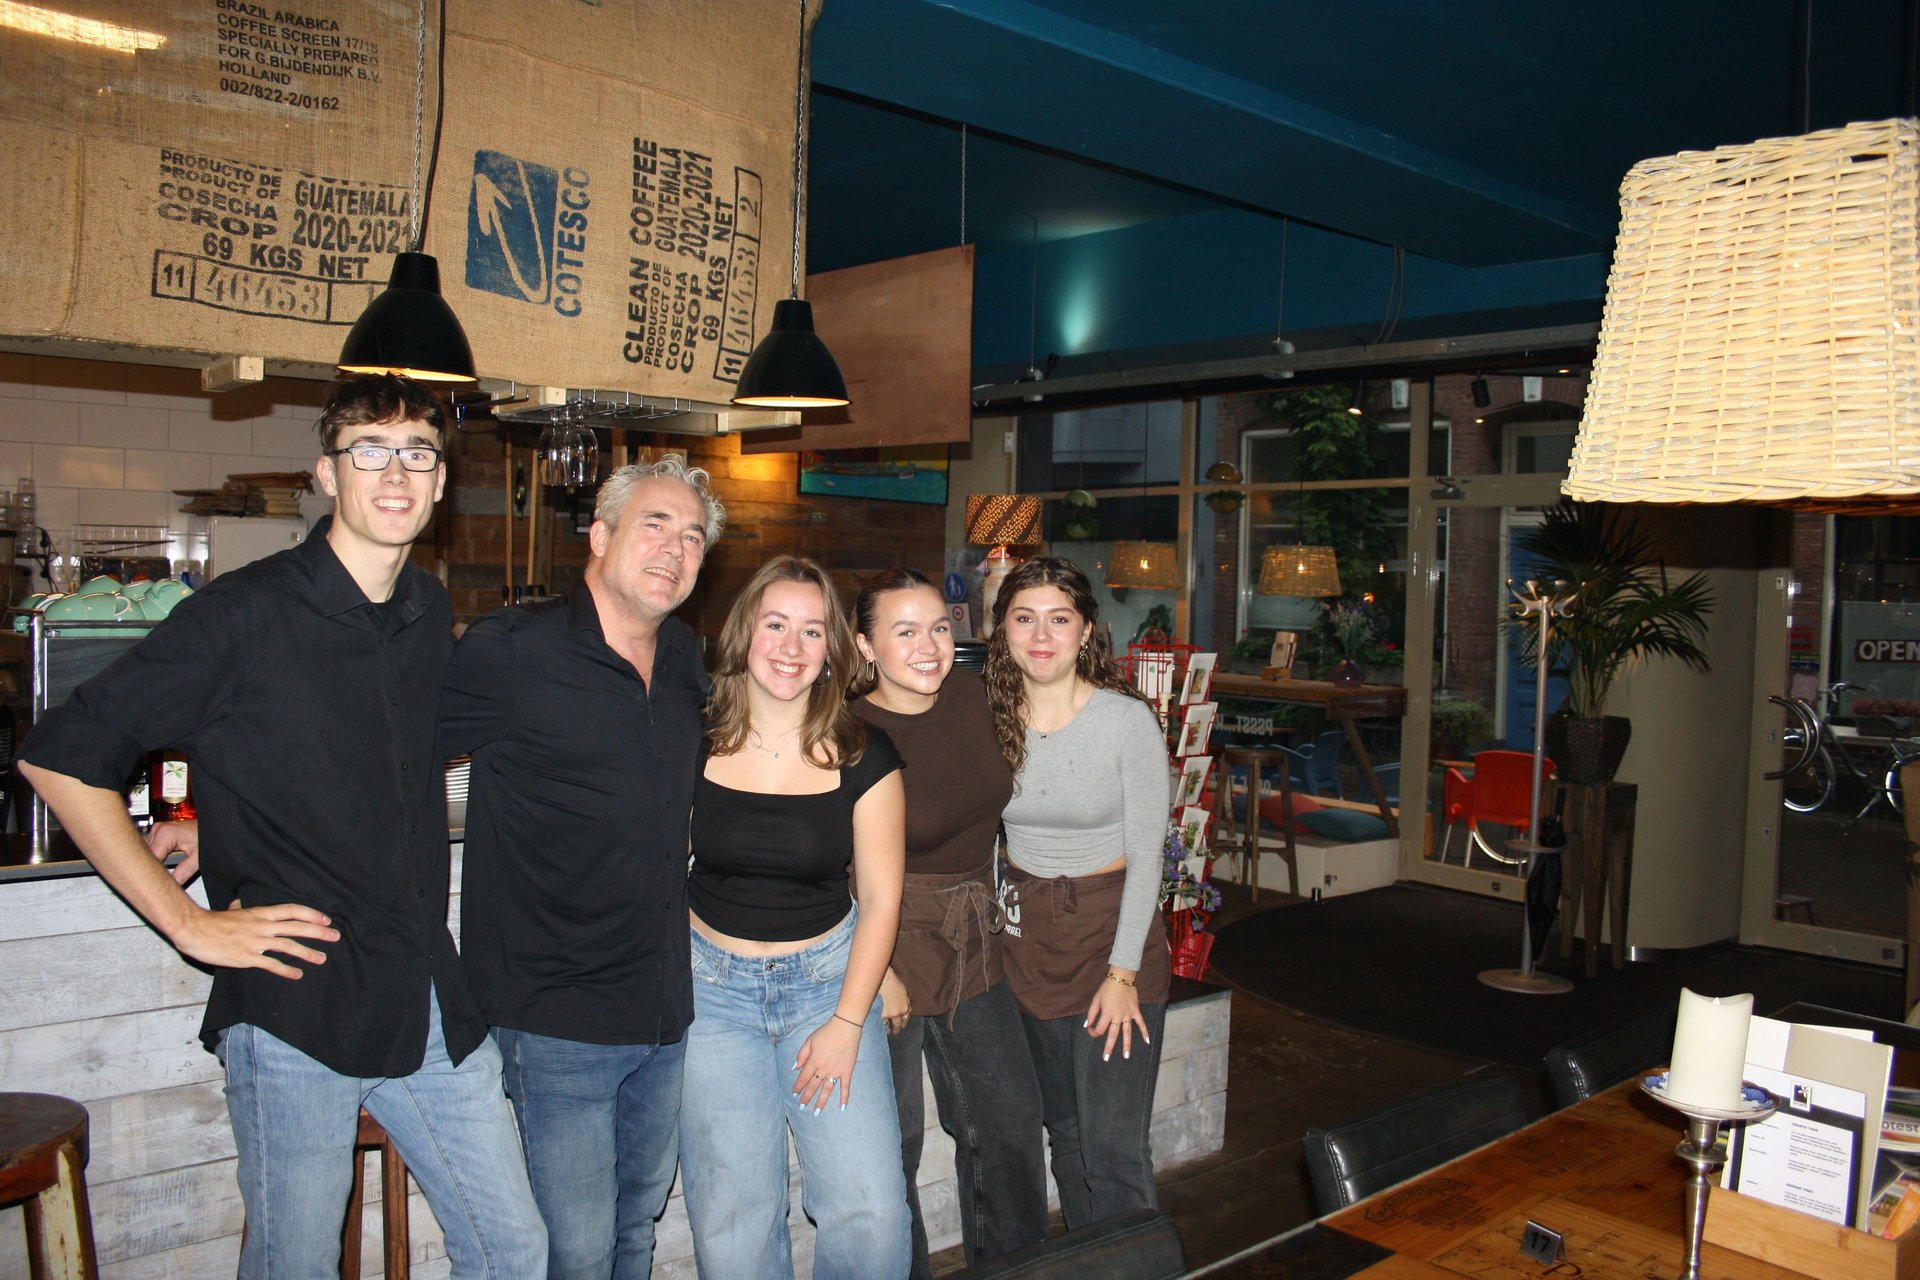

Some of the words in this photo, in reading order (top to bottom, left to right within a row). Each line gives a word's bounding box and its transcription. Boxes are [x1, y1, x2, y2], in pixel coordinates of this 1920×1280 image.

[216, 0, 270, 20] BRAZIL
[274, 11, 339, 31] ARABICA
[217, 13, 277, 37] COFFEE
[281, 28, 340, 48] SCREEN
[345, 37, 378, 54] 17/18
[217, 28, 299, 56] SPECIALLY
[303, 47, 379, 66] PREPARED
[218, 44, 250, 60] FOR
[255, 52, 353, 78] G.BIJDENDIJK
[219, 60, 291, 85] HOLLAND
[220, 77, 339, 111] 002/822-2/0162
[160, 163, 251, 195] PRODUCT
[256, 187, 281, 200] OF
[161, 149, 255, 182] PRODUCTO
[260, 173, 282, 188] DE
[158, 182, 278, 221] COSECHA
[295, 180, 411, 217] GUATEMALA
[629, 136, 657, 246] COFFEE
[655, 147, 682, 252] GUATEMALA
[677, 150, 713, 262] 2020-2021
[158, 203, 278, 239] CROP
[292, 208, 418, 254] 2020-2021
[712, 196, 734, 243] NET
[203, 232, 233, 260] 69
[250, 243, 302, 271] KGS
[319, 254, 369, 279] NET
[554, 166, 591, 318] COTESCO
[163, 263, 185, 288] 11
[706, 255, 727, 302] KGS
[723, 357, 743, 375] 11
[739, 196, 758, 218] 2
[623, 256, 650, 363] CLEAN
[644, 286, 660, 365] PRODUCTO
[652, 262, 662, 283] DE
[653, 292, 670, 368] PRODUCT
[663, 265, 672, 288] OF
[666, 272, 688, 370] COSECHA
[681, 274, 703, 373] CROP
[701, 314, 721, 341] 69
[1859, 640, 1920, 660] OPEN
[1531, 1232, 1550, 1254] 17
